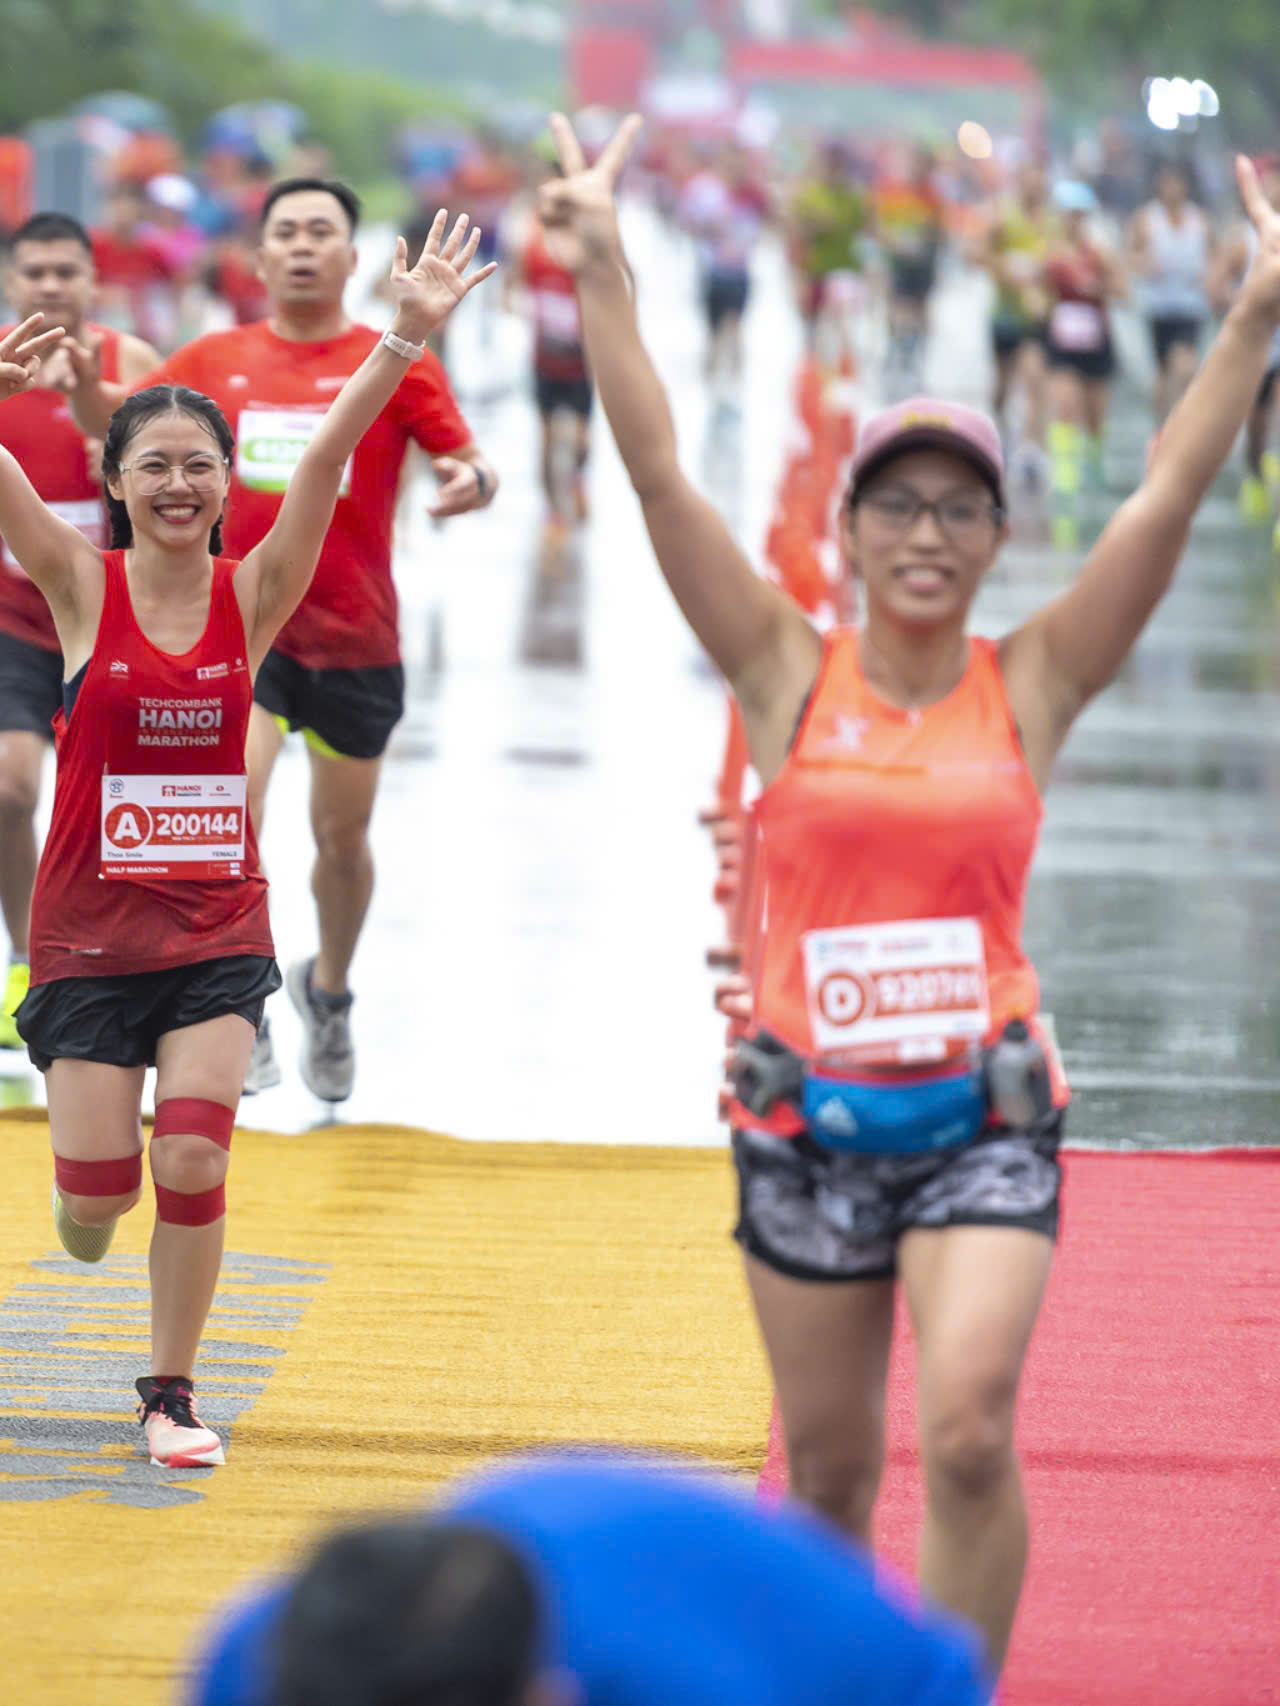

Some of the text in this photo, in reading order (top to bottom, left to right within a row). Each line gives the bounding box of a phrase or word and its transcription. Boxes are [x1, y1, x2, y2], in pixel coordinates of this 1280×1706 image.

[138, 697, 222, 709] TECHCOMBANK
[139, 709, 222, 729] HANOI
[137, 735, 220, 747] MARATHON
[112, 811, 239, 841] A 200144
